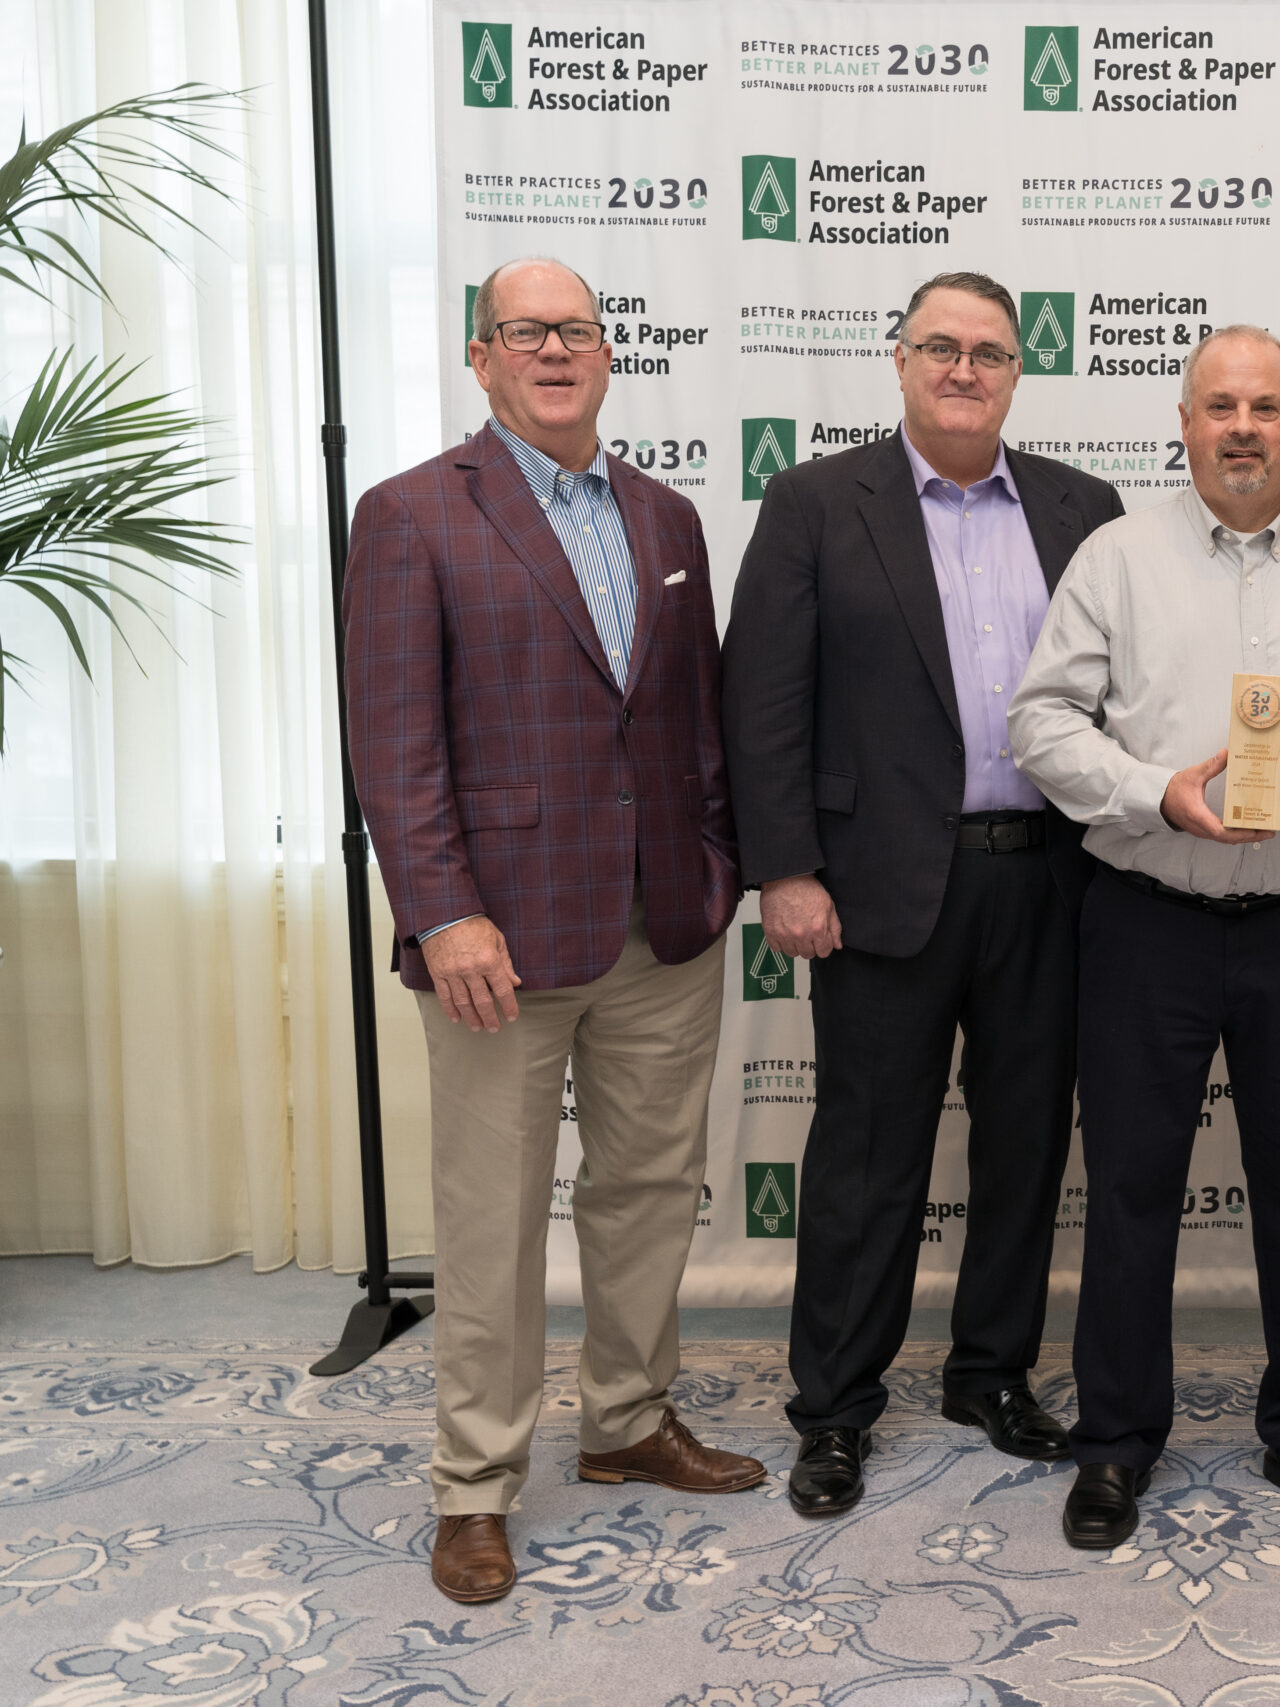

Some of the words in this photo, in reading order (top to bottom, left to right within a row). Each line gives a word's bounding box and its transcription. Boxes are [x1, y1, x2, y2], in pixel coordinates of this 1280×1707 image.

[527, 26, 645, 50] American
[1093, 25, 1213, 49] American
[741, 40, 795, 55] BETTER
[801, 44, 879, 56] PRACTICES
[741, 57, 806, 75] BETTER
[814, 61, 880, 76] PLANET
[887, 43, 989, 76] 2030
[529, 57, 606, 81] Forest
[612, 58, 630, 80] &
[637, 59, 708, 88] Paper
[1094, 59, 1171, 81] Forest
[1178, 58, 1197, 80] &
[1205, 58, 1276, 86] Paper
[741, 80, 805, 92] SUSTAINABLE
[808, 83, 855, 93] PRODUCTS
[858, 84, 874, 93] FOR
[877, 84, 884, 92] A
[887, 84, 950, 93] SUSTAINABLE
[953, 84, 987, 93] FUTURE
[528, 88, 670, 112] Association
[1092, 88, 1237, 112] Association
[809, 159, 925, 183] American
[465, 173, 513, 187] BETTER
[520, 176, 601, 189] PRACTICES
[1022, 179, 1076, 190] BETTER
[1082, 179, 1162, 190] PRACTICES
[465, 190, 525, 207] BETTER
[533, 193, 602, 209] PLANET
[607, 177, 708, 210] 2030
[1022, 196, 1087, 210] BETTER
[1094, 195, 1164, 210] PLANET
[1169, 177, 1273, 210] 2030
[810, 191, 885, 214] Forest
[892, 192, 910, 214] &
[917, 191, 988, 220] Paper
[465, 211, 524, 223] SUSTAINABLE
[527, 215, 575, 224] PRODUCTS
[578, 216, 596, 225] FOR
[599, 217, 605, 225] A
[607, 217, 669, 226] SUSTAINABLE
[672, 217, 706, 226] FUTURE
[1022, 218, 1085, 227] SUSTAINABLE
[1088, 218, 1136, 226] PRODUCTS
[1139, 218, 1157, 226] FOR
[1159, 217, 1166, 226] A
[1169, 217, 1233, 226] SUSTAINABLE
[1236, 217, 1270, 226] FUTURE
[808, 221, 949, 244] Association
[1088, 292, 1207, 315] American
[741, 306, 795, 319] BETTER
[801, 310, 877, 322] PRACTICES
[614, 323, 630, 344] &
[638, 323, 708, 351] Paper
[741, 322, 807, 340] BETTER
[812, 326, 878, 341] PLANET
[1090, 324, 1166, 346] Forest
[1172, 323, 1191, 345] &
[741, 344, 805, 356] SUSTAINABLE
[808, 348, 852, 357] PRODUCTS
[855, 349, 872, 357] FOR
[875, 349, 881, 357] A
[1018, 441, 1071, 452] BETTER
[1077, 441, 1158, 452] PRACTICES
[1090, 458, 1158, 471] PLANET
[673, 478, 706, 486] FUTURE
[1134, 480, 1151, 488] FOR
[743, 1060, 794, 1073] BETTER
[744, 1076, 805, 1090] BETTER
[743, 1095, 804, 1105] SUSTAINABLE
[1212, 1220, 1244, 1229] FUTURE
